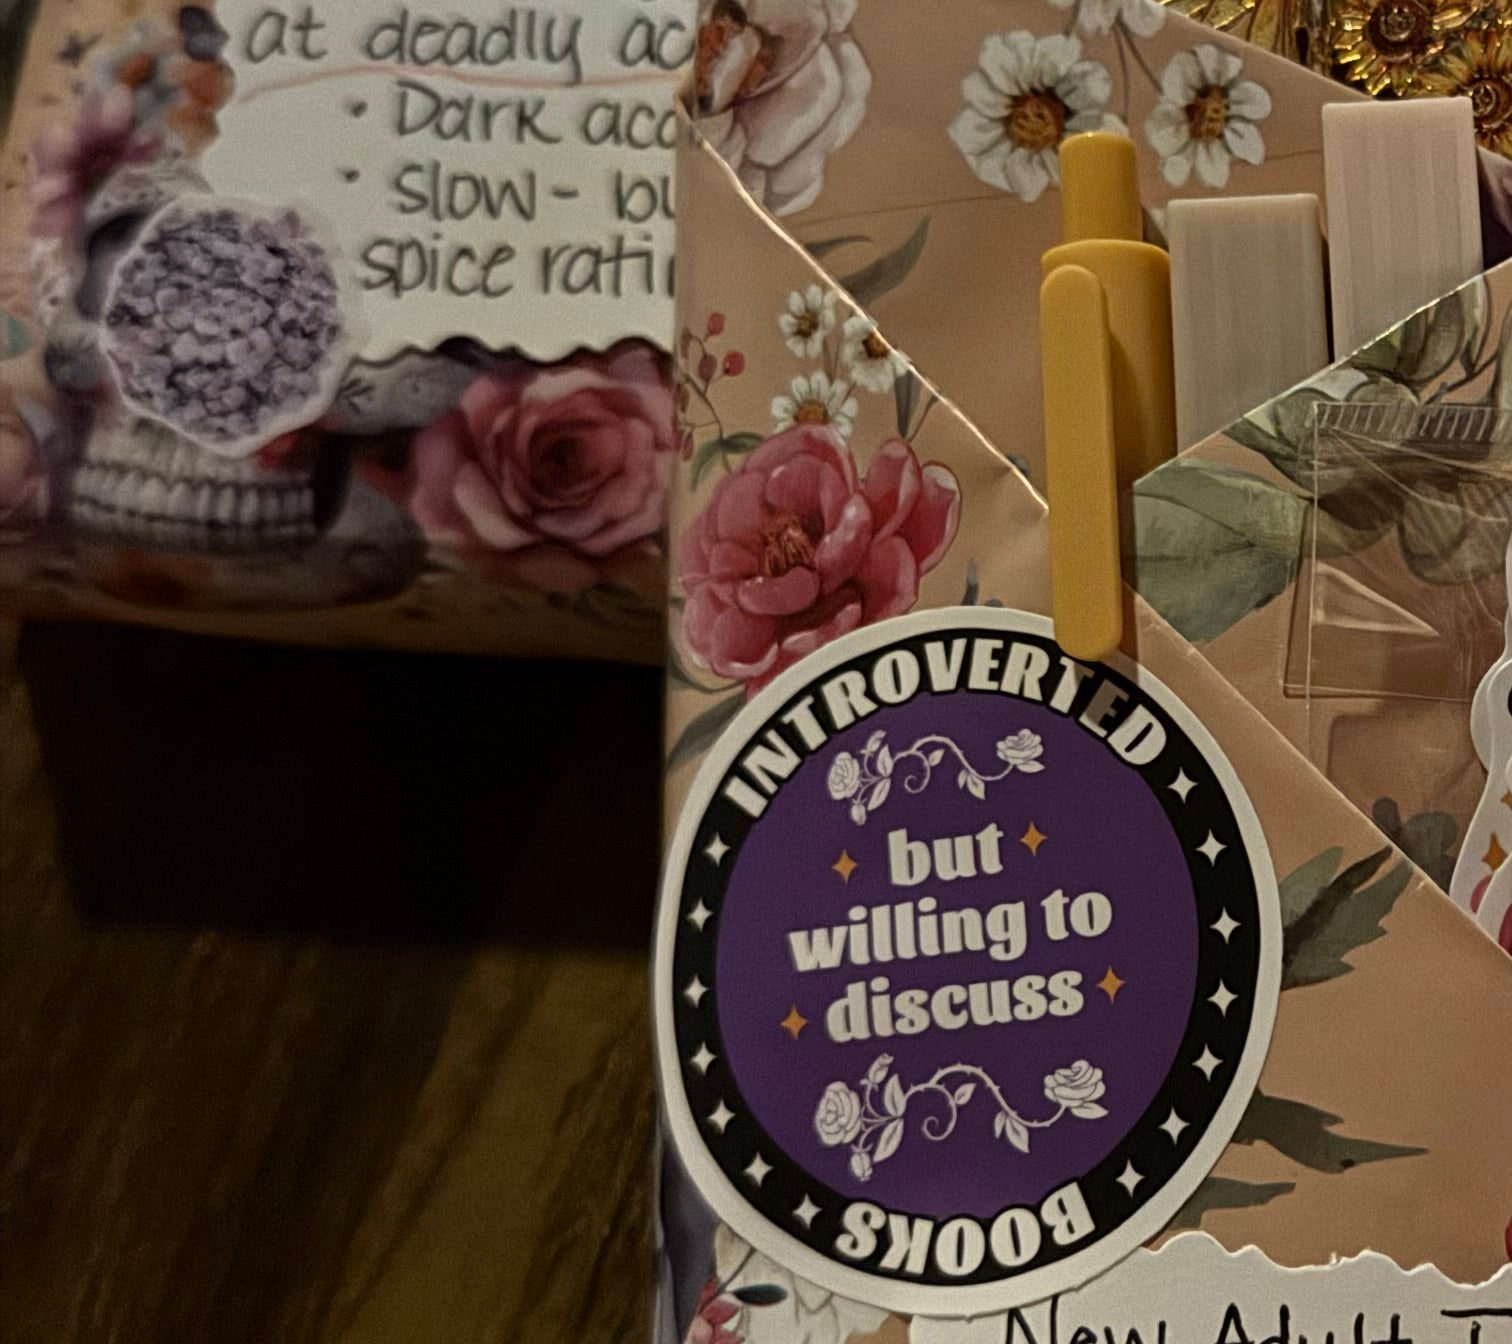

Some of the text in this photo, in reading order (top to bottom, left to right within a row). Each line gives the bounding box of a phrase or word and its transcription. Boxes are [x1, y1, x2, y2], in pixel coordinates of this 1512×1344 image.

[245, 8, 327, 61] at
[365, 8, 583, 89] deadly
[396, 80, 563, 144] Dark
[541, 231, 676, 298] rati
[723, 636, 1169, 820] INTROVERTED
[886, 820, 1005, 887] but
[786, 887, 1114, 974] willing to
[824, 968, 1086, 1044] discuss
[834, 1178, 1098, 1278] BOOKS
